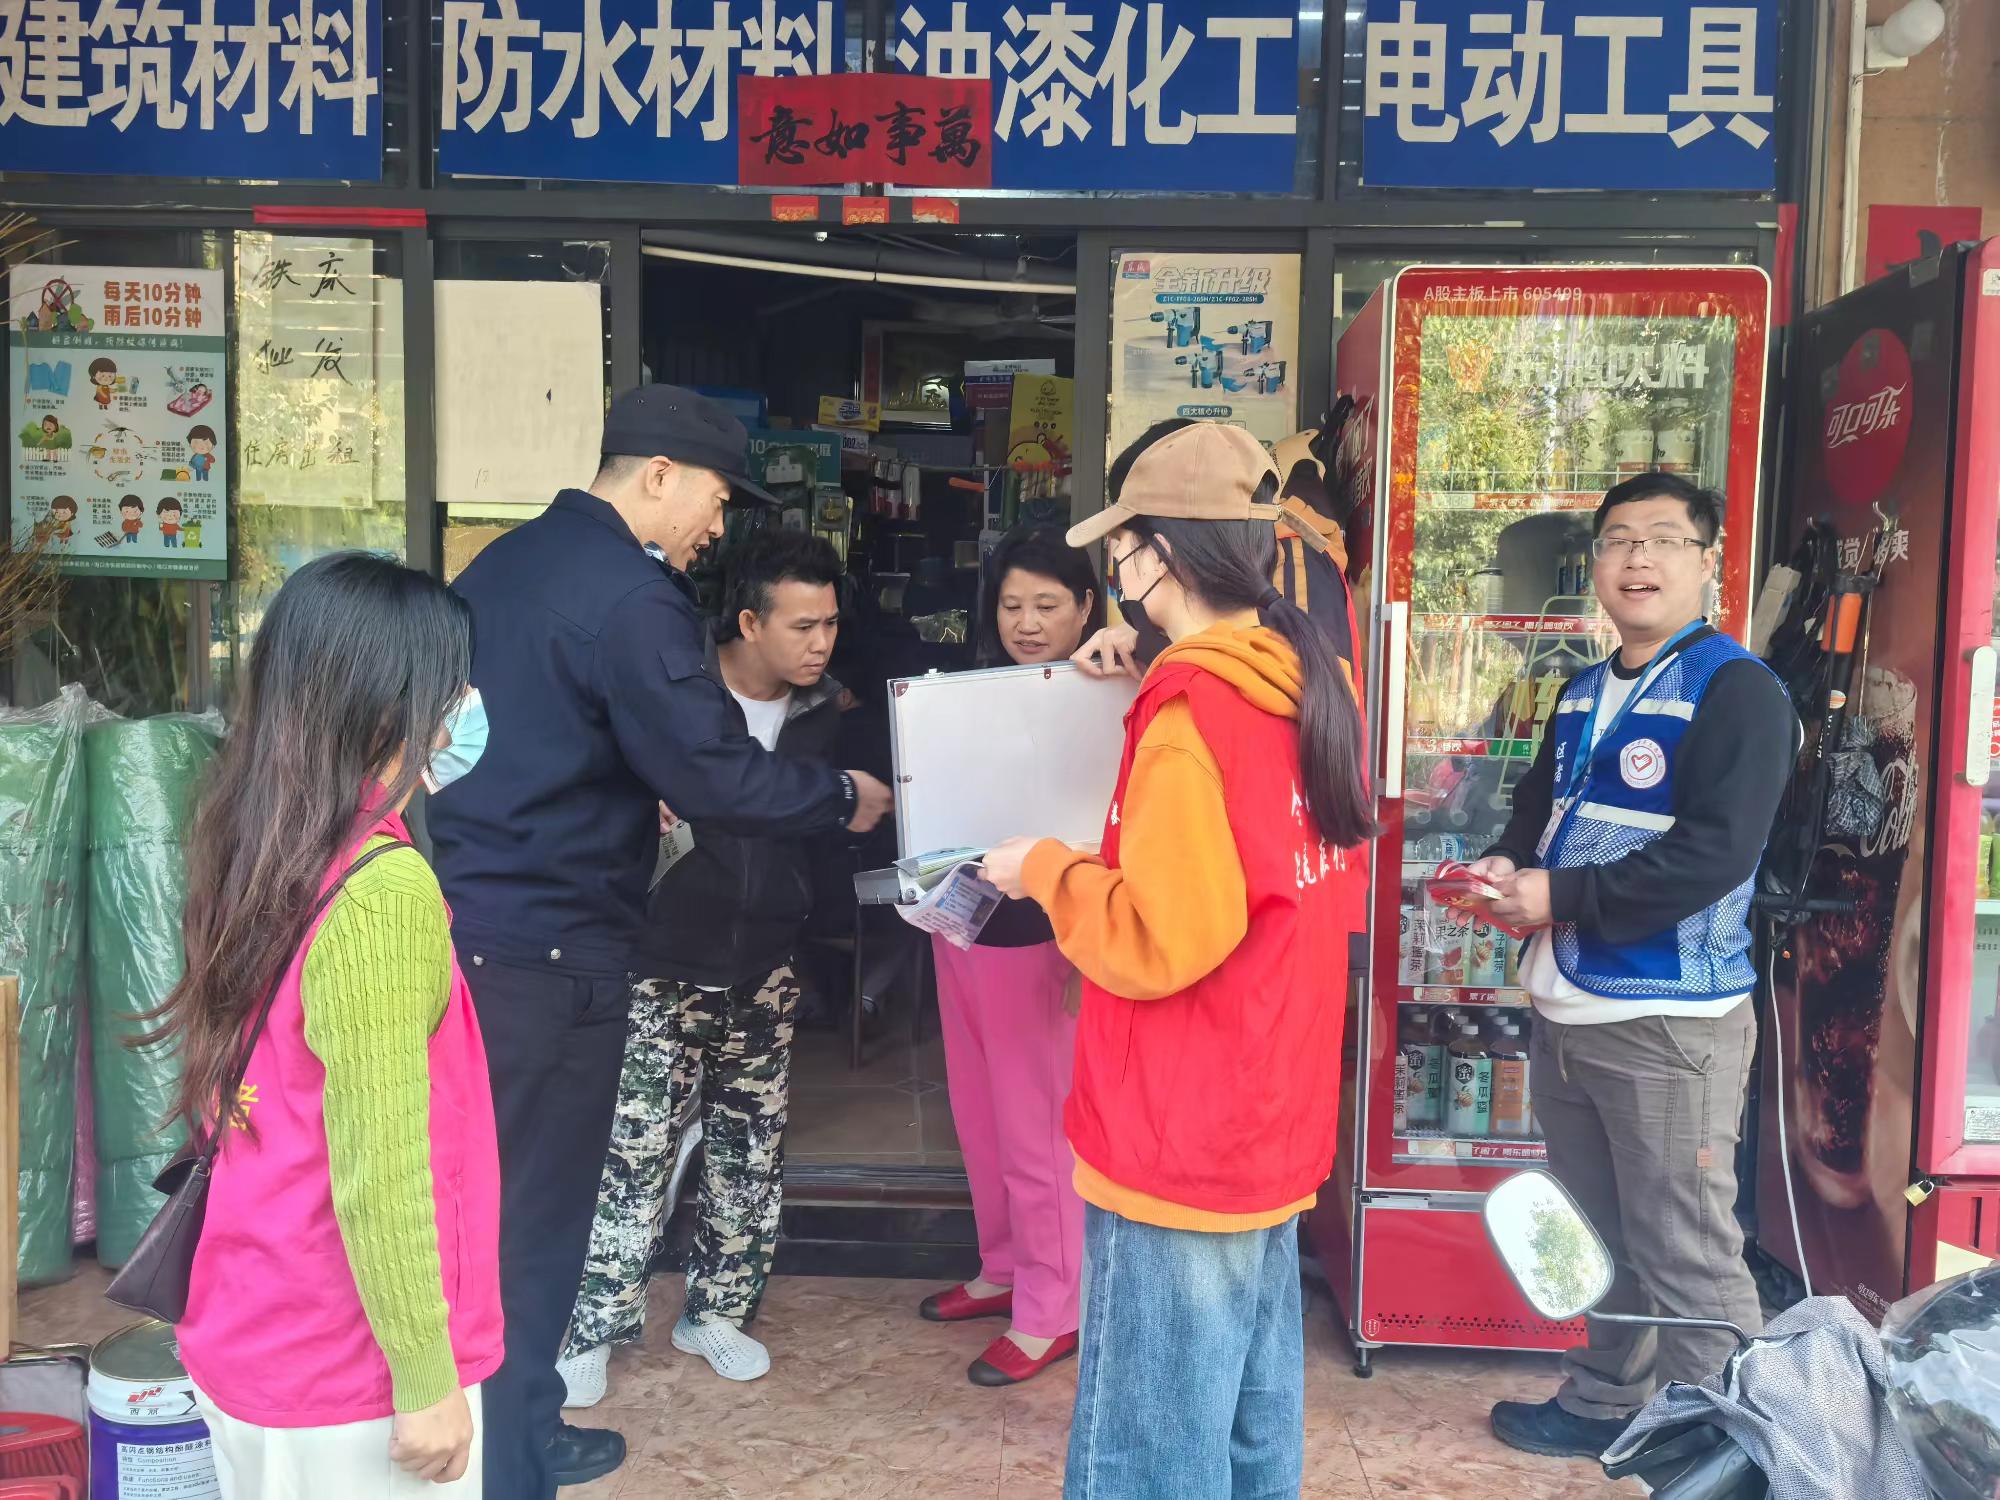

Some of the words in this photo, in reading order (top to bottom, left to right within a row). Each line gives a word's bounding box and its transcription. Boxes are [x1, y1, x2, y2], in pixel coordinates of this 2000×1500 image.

[0, 0, 378, 136] 建筑材料
[1365, 0, 1774, 149] 电动工具
[103, 280, 202, 304] 每天10分钟
[1152, 266, 1271, 295] 全新升级
[1423, 286, 1519, 302] A股主板上市
[1523, 286, 1583, 301] 605499
[103, 304, 202, 329] 雨后10分钟
[1826, 381, 1908, 448] 可口可乐
[1493, 931, 1506, 973] 子蜜茶
